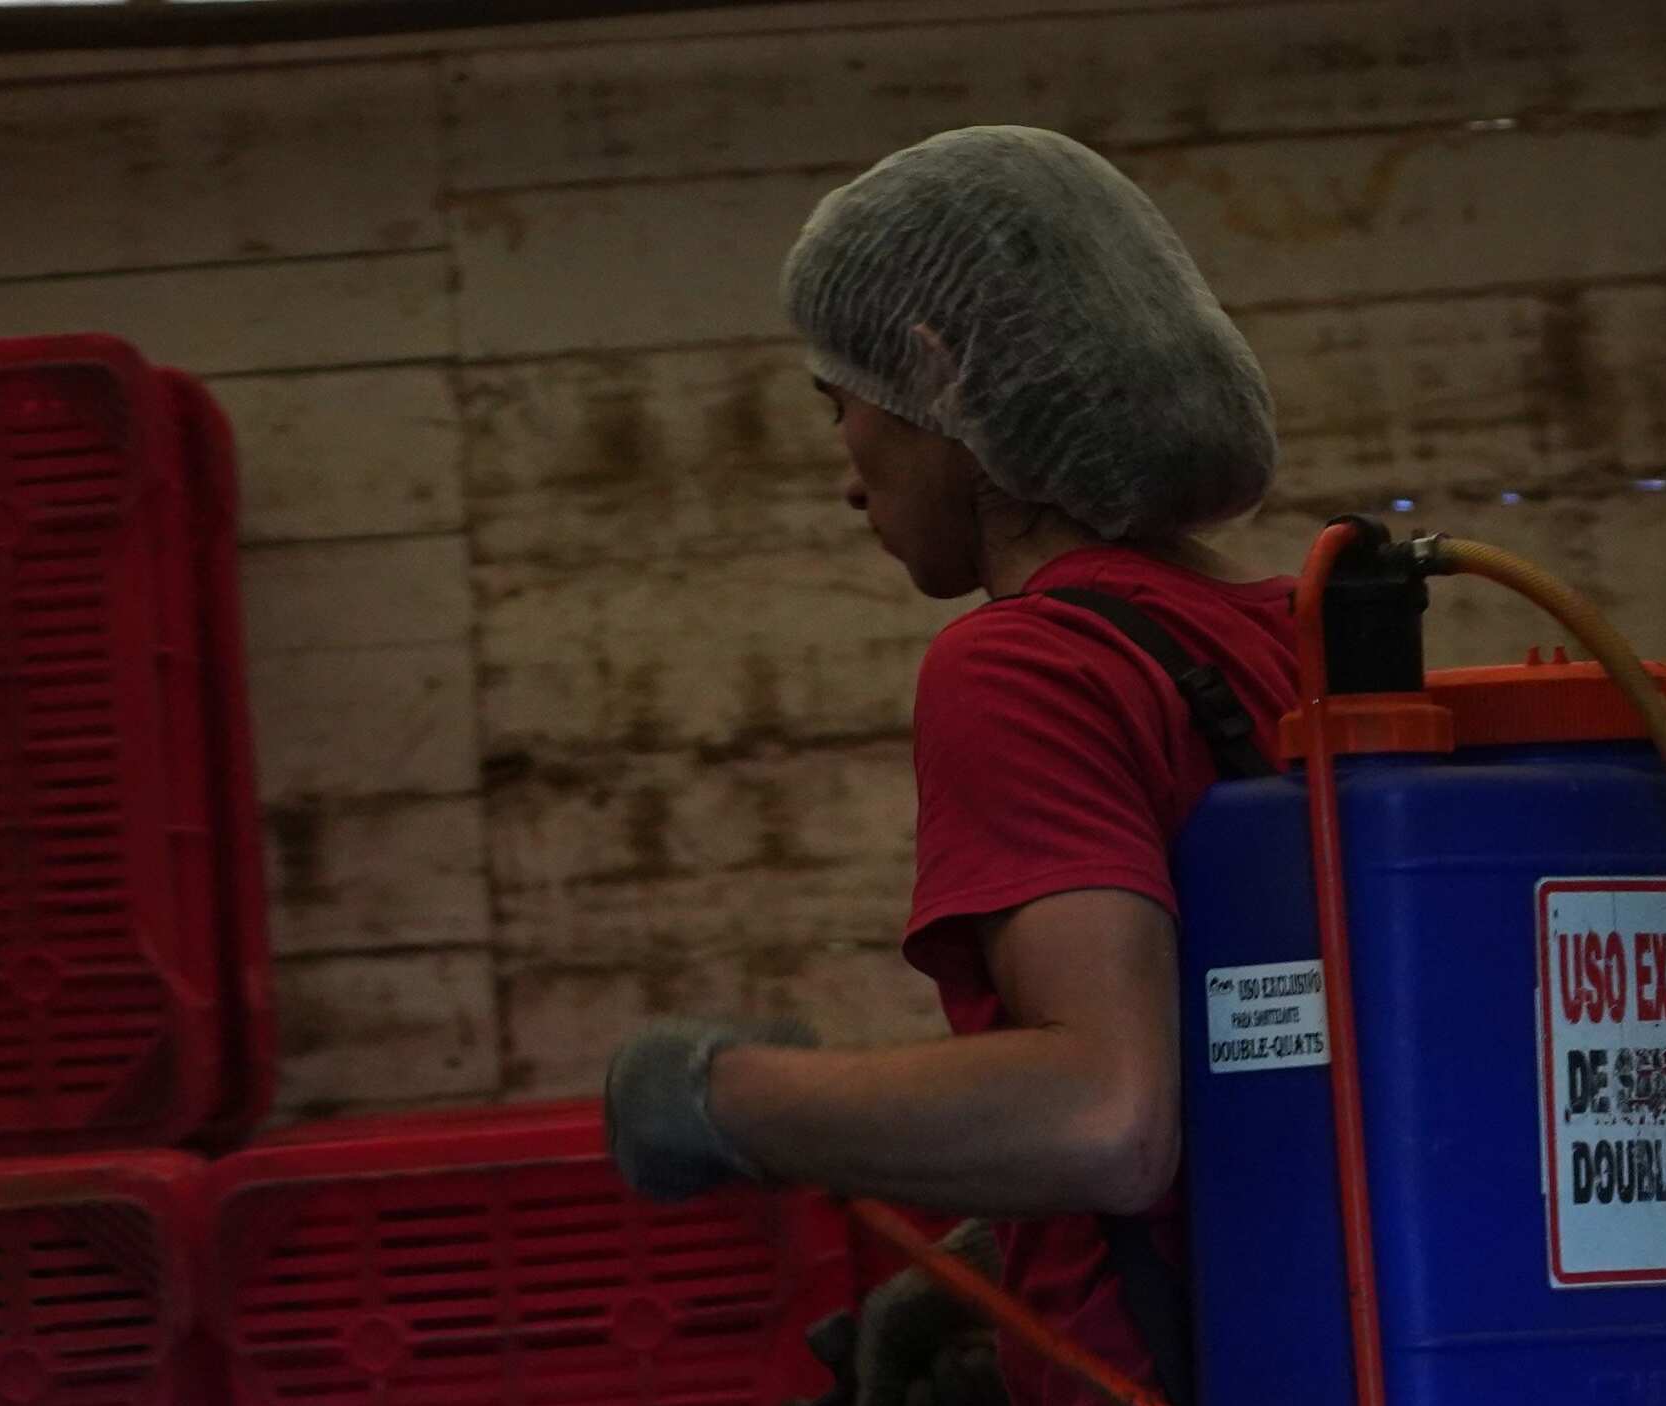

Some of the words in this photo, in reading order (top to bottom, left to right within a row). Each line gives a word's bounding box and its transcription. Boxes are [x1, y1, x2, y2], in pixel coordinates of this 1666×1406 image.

[1559, 931, 1627, 1024] USO
[1212, 1033, 1325, 1062] DOUBLE-QUATS
[1568, 1050, 1610, 1113] DE
